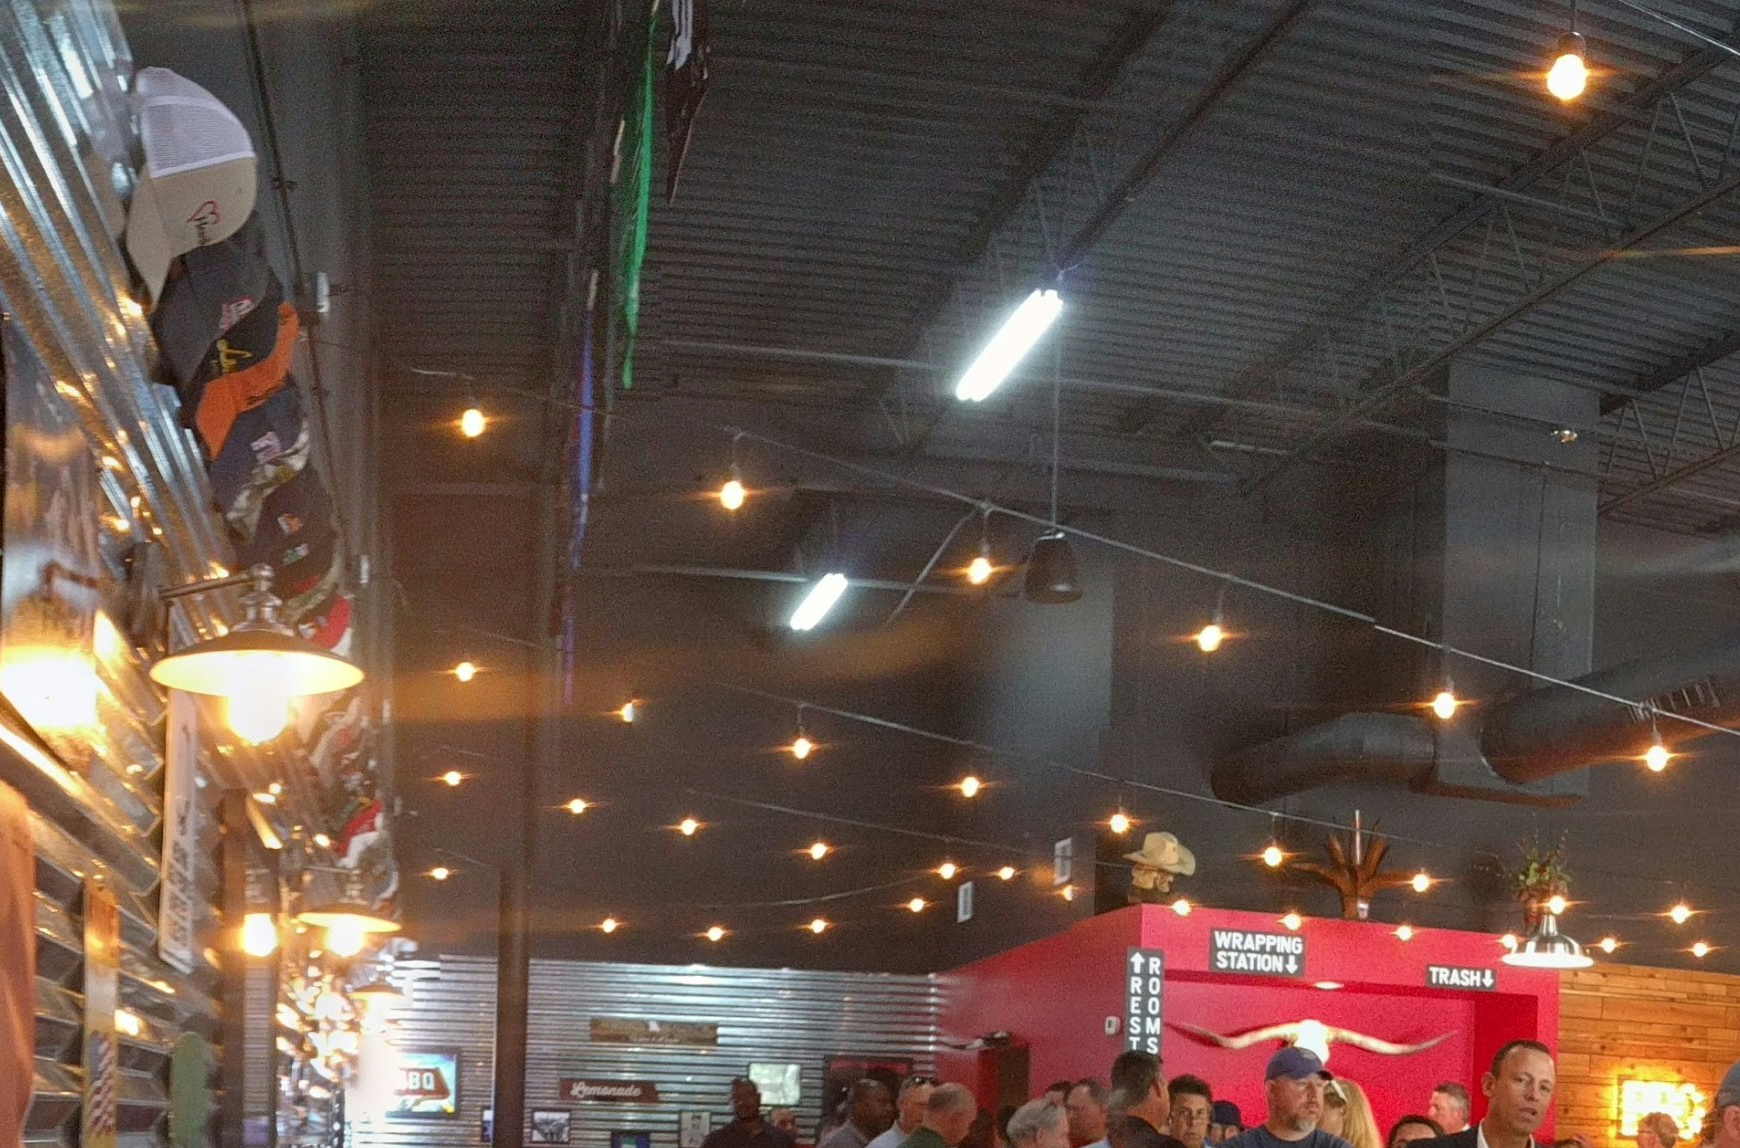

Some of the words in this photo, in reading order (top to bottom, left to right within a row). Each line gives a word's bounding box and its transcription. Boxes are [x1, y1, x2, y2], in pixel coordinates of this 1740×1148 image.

[1214, 931, 1303, 955] WRAPPING
[1216, 951, 1284, 972] STATION
[1429, 966, 1481, 989] TRASH
[570, 1081, 642, 1099] Lemonade
